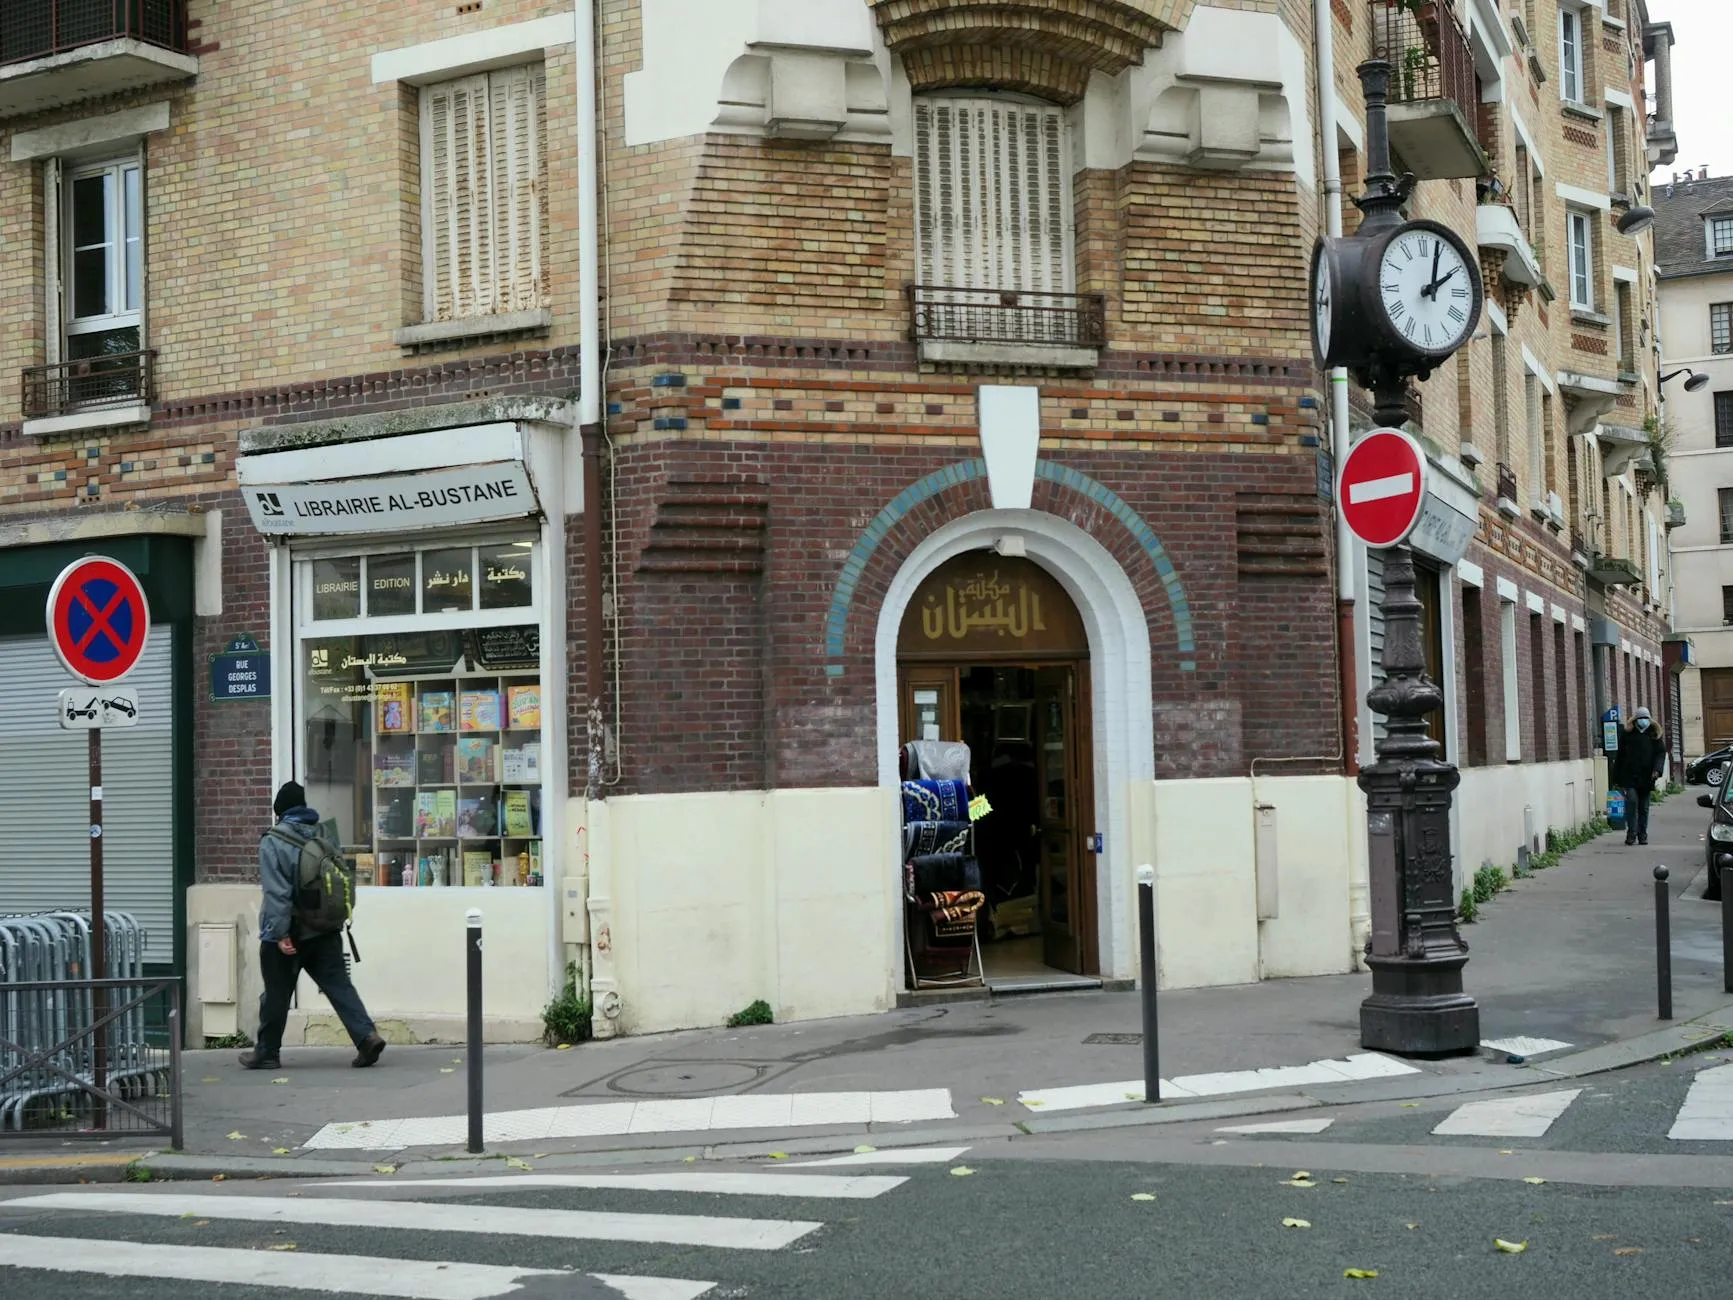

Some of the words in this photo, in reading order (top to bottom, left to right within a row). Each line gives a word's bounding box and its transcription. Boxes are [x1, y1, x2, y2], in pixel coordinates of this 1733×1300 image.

[1451, 288, 1466, 298] III
[294, 496, 384, 517] LIBRAIRIE
[388, 479, 518, 512] AL-BUSTANE
[427, 571, 449, 589] نشر
[452, 570, 469, 587] دار
[487, 565, 526, 582] مكتبة
[316, 581, 358, 594] LIBRAIRIE
[374, 577, 410, 590] EDITION
[964, 570, 1010, 600] مكتبة
[922, 584, 1047, 640] البستان
[236, 660, 249, 669] RUE
[341, 653, 376, 669] البستان
[377, 652, 407, 666] مكتبة
[228, 672, 257, 681] GEORGES
[228, 684, 256, 693] DESPLAS
[1610, 709, 1617, 721] P
